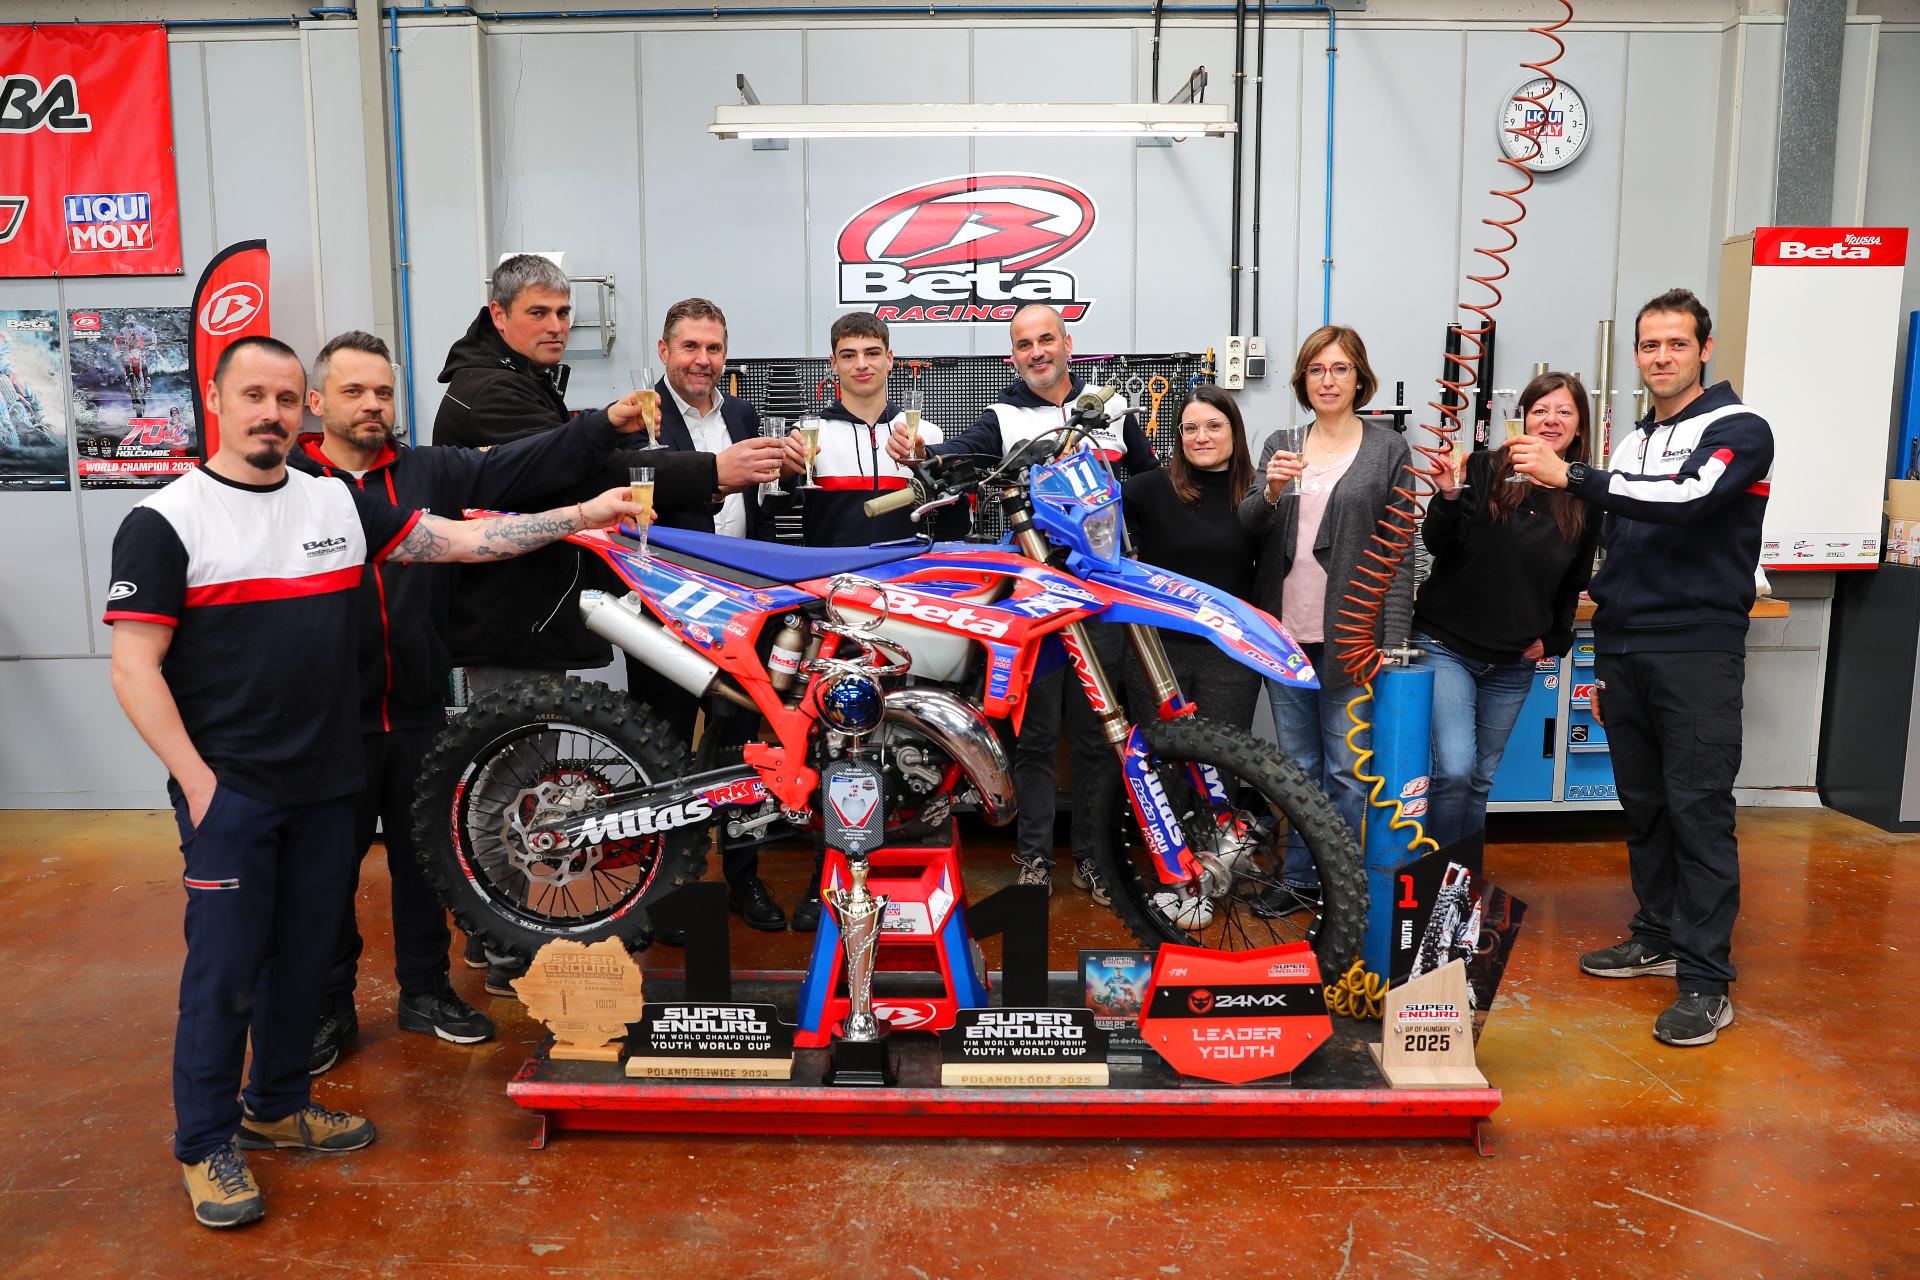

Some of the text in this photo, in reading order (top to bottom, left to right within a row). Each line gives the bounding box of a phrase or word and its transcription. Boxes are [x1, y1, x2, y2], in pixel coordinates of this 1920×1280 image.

[1559, 92, 1563, 100] 1
[1514, 103, 1522, 111] 10
[1568, 104, 1574, 112] 2
[1510, 118, 1515, 126] 9
[1572, 120, 1577, 128] 3
[1540, 151, 1544, 159] 6
[1555, 147, 1560, 155] 5
[69, 196, 147, 222] LIQUI
[72, 223, 149, 249] MOLY
[1779, 241, 1871, 259] Beta
[840, 261, 1074, 301] Beta
[876, 304, 1018, 320] RACING
[119, 417, 169, 446] 70
[1662, 448, 1692, 457] Beta
[86, 461, 194, 472] WORLD CHAMPION 2020
[1065, 461, 1098, 497] 11
[302, 536, 346, 551] Beta
[660, 580, 729, 619] 11
[870, 590, 1009, 638] Beta
[771, 655, 799, 669] Beta
[1568, 785, 1617, 798] PAIOL
[571, 798, 713, 847] Mitas
[1141, 827, 1161, 855] MOLY
[1149, 822, 1170, 852] LIQUI
[1398, 874, 1418, 909] 1
[882, 920, 913, 929] eta
[1400, 919, 1413, 950] YOUTH
[1215, 994, 1287, 1007] 24MX
[663, 1007, 756, 1020] SUPER
[976, 1012, 1072, 1025] SUPER
[652, 1020, 767, 1033] ENDURO
[966, 1025, 1083, 1039] ENDURO
[1192, 1027, 1281, 1041] LEADER
[651, 1041, 771, 1050] YOUTH WORLD CUP
[1405, 1035, 1450, 1051] 2025
[963, 1048, 1086, 1056] YOUTH WORLD CUP
[1198, 1045, 1275, 1059] YOUTH
[647, 1068, 735, 1077] POLAND/GLIWICE
